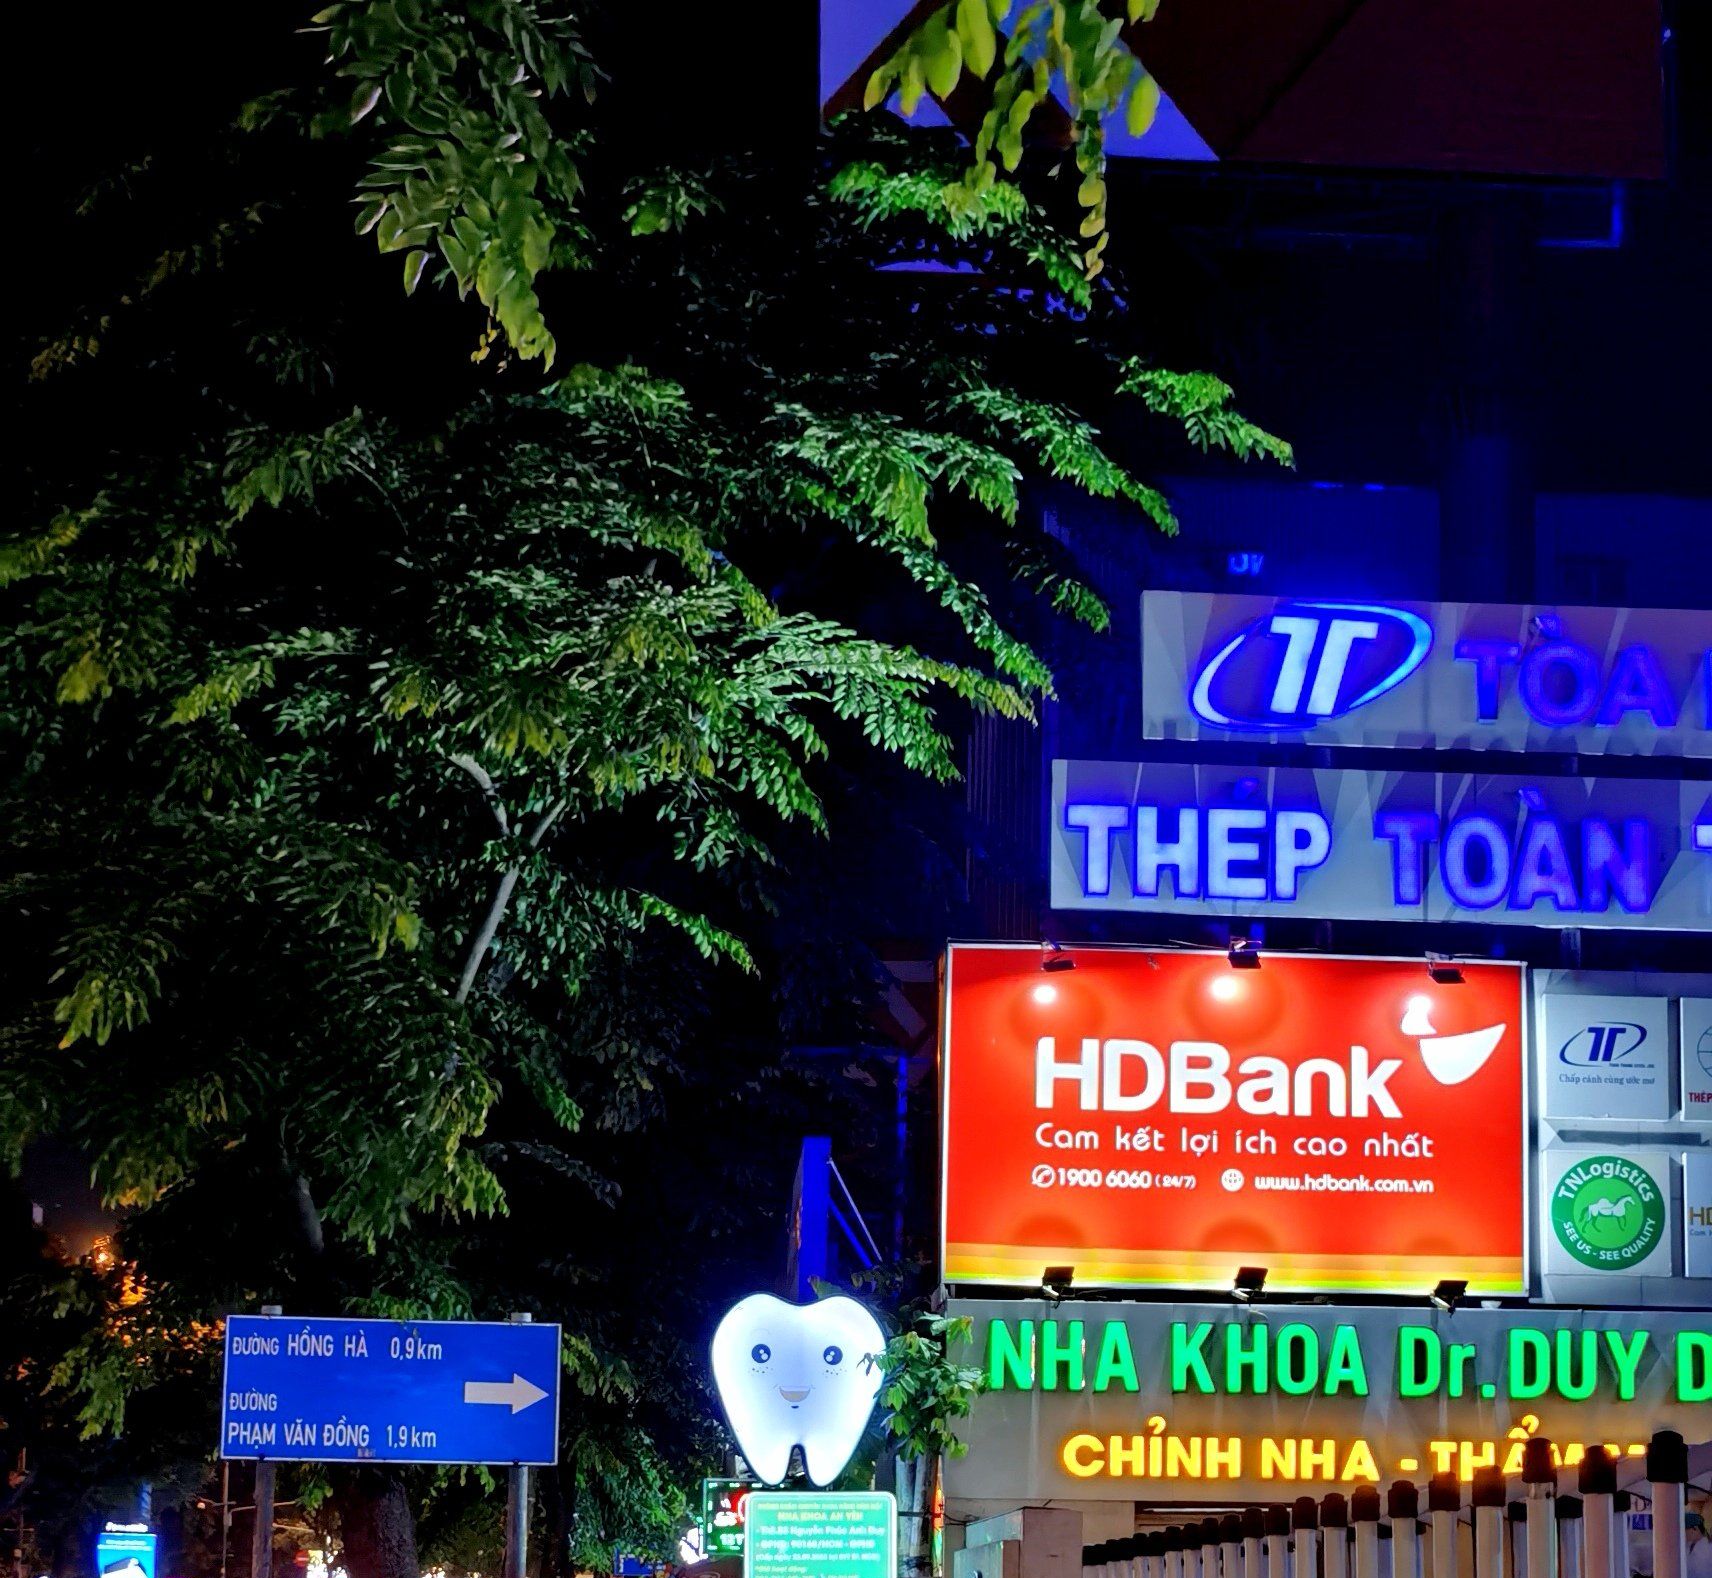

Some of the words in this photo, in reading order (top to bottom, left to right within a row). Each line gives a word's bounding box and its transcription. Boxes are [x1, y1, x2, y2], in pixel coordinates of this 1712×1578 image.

[1065, 777, 1332, 902] THÉP
[1375, 787, 1650, 913] TOÀN
[1035, 1037, 1403, 1118] HDBank
[1559, 1073, 1580, 1084] Chấp
[1036, 1122, 1099, 1150] Cam
[1115, 1125, 1164, 1152] kết
[1181, 1128, 1219, 1158] lợi
[1235, 1129, 1277, 1154] ích
[1294, 1137, 1347, 1156] cao
[1364, 1132, 1434, 1157] nhất
[1057, 1168, 1102, 1187] 1900
[1106, 1170, 1151, 1188] 6060
[1255, 1174, 1434, 1193] www.hdbank.com.vn
[1558, 1160, 1654, 1202] TNLogistics
[1563, 1221, 1579, 1242] SEE
[1576, 1240, 1592, 1255] US
[1599, 1250, 1620, 1261] SEE
[1621, 1217, 1656, 1258] QUALITY
[232, 1331, 280, 1356] ĐƯỜNG
[288, 1326, 334, 1356] HỒNG
[345, 1329, 368, 1358] HÀ
[990, 1318, 1140, 1392] NHA
[1171, 1321, 1370, 1396] KHOA
[229, 1387, 277, 1411] ĐƯỜNG
[227, 1422, 275, 1449] PHẠM
[284, 1418, 316, 1446] VĂN
[322, 1415, 370, 1447] ĐỒNG
[1063, 1416, 1242, 1479] CHỈNH
[1261, 1437, 1380, 1481] NHA
